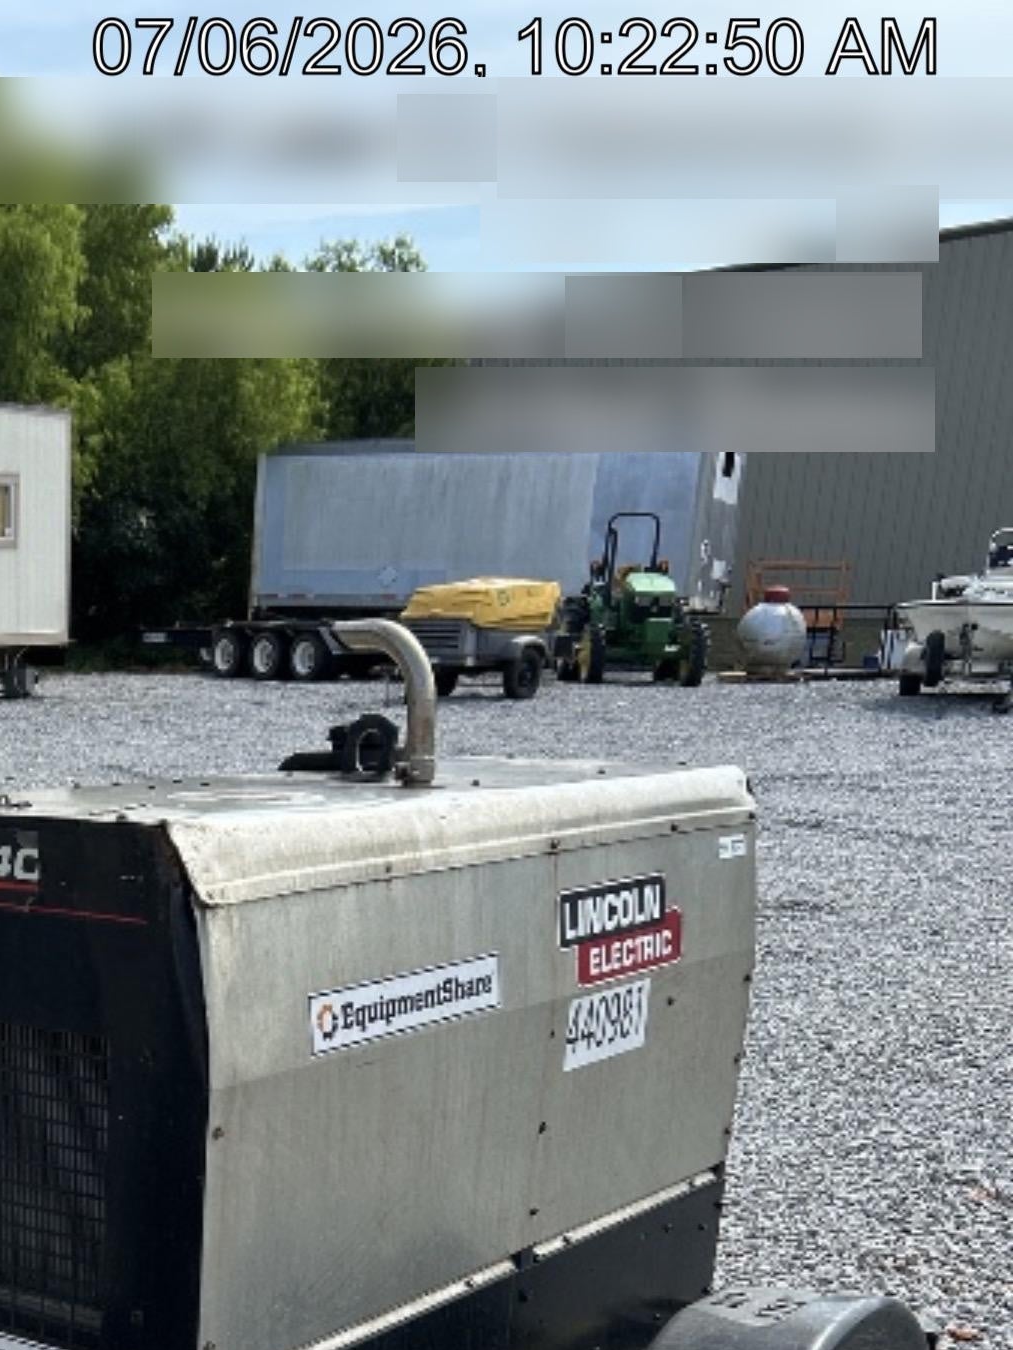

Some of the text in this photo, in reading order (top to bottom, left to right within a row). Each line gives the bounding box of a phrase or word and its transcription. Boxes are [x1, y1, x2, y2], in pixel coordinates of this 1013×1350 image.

[564, 884, 661, 940] LINCOLN
[589, 929, 673, 976] ELECTRIC
[341, 974, 493, 1031] EquipmentShare
